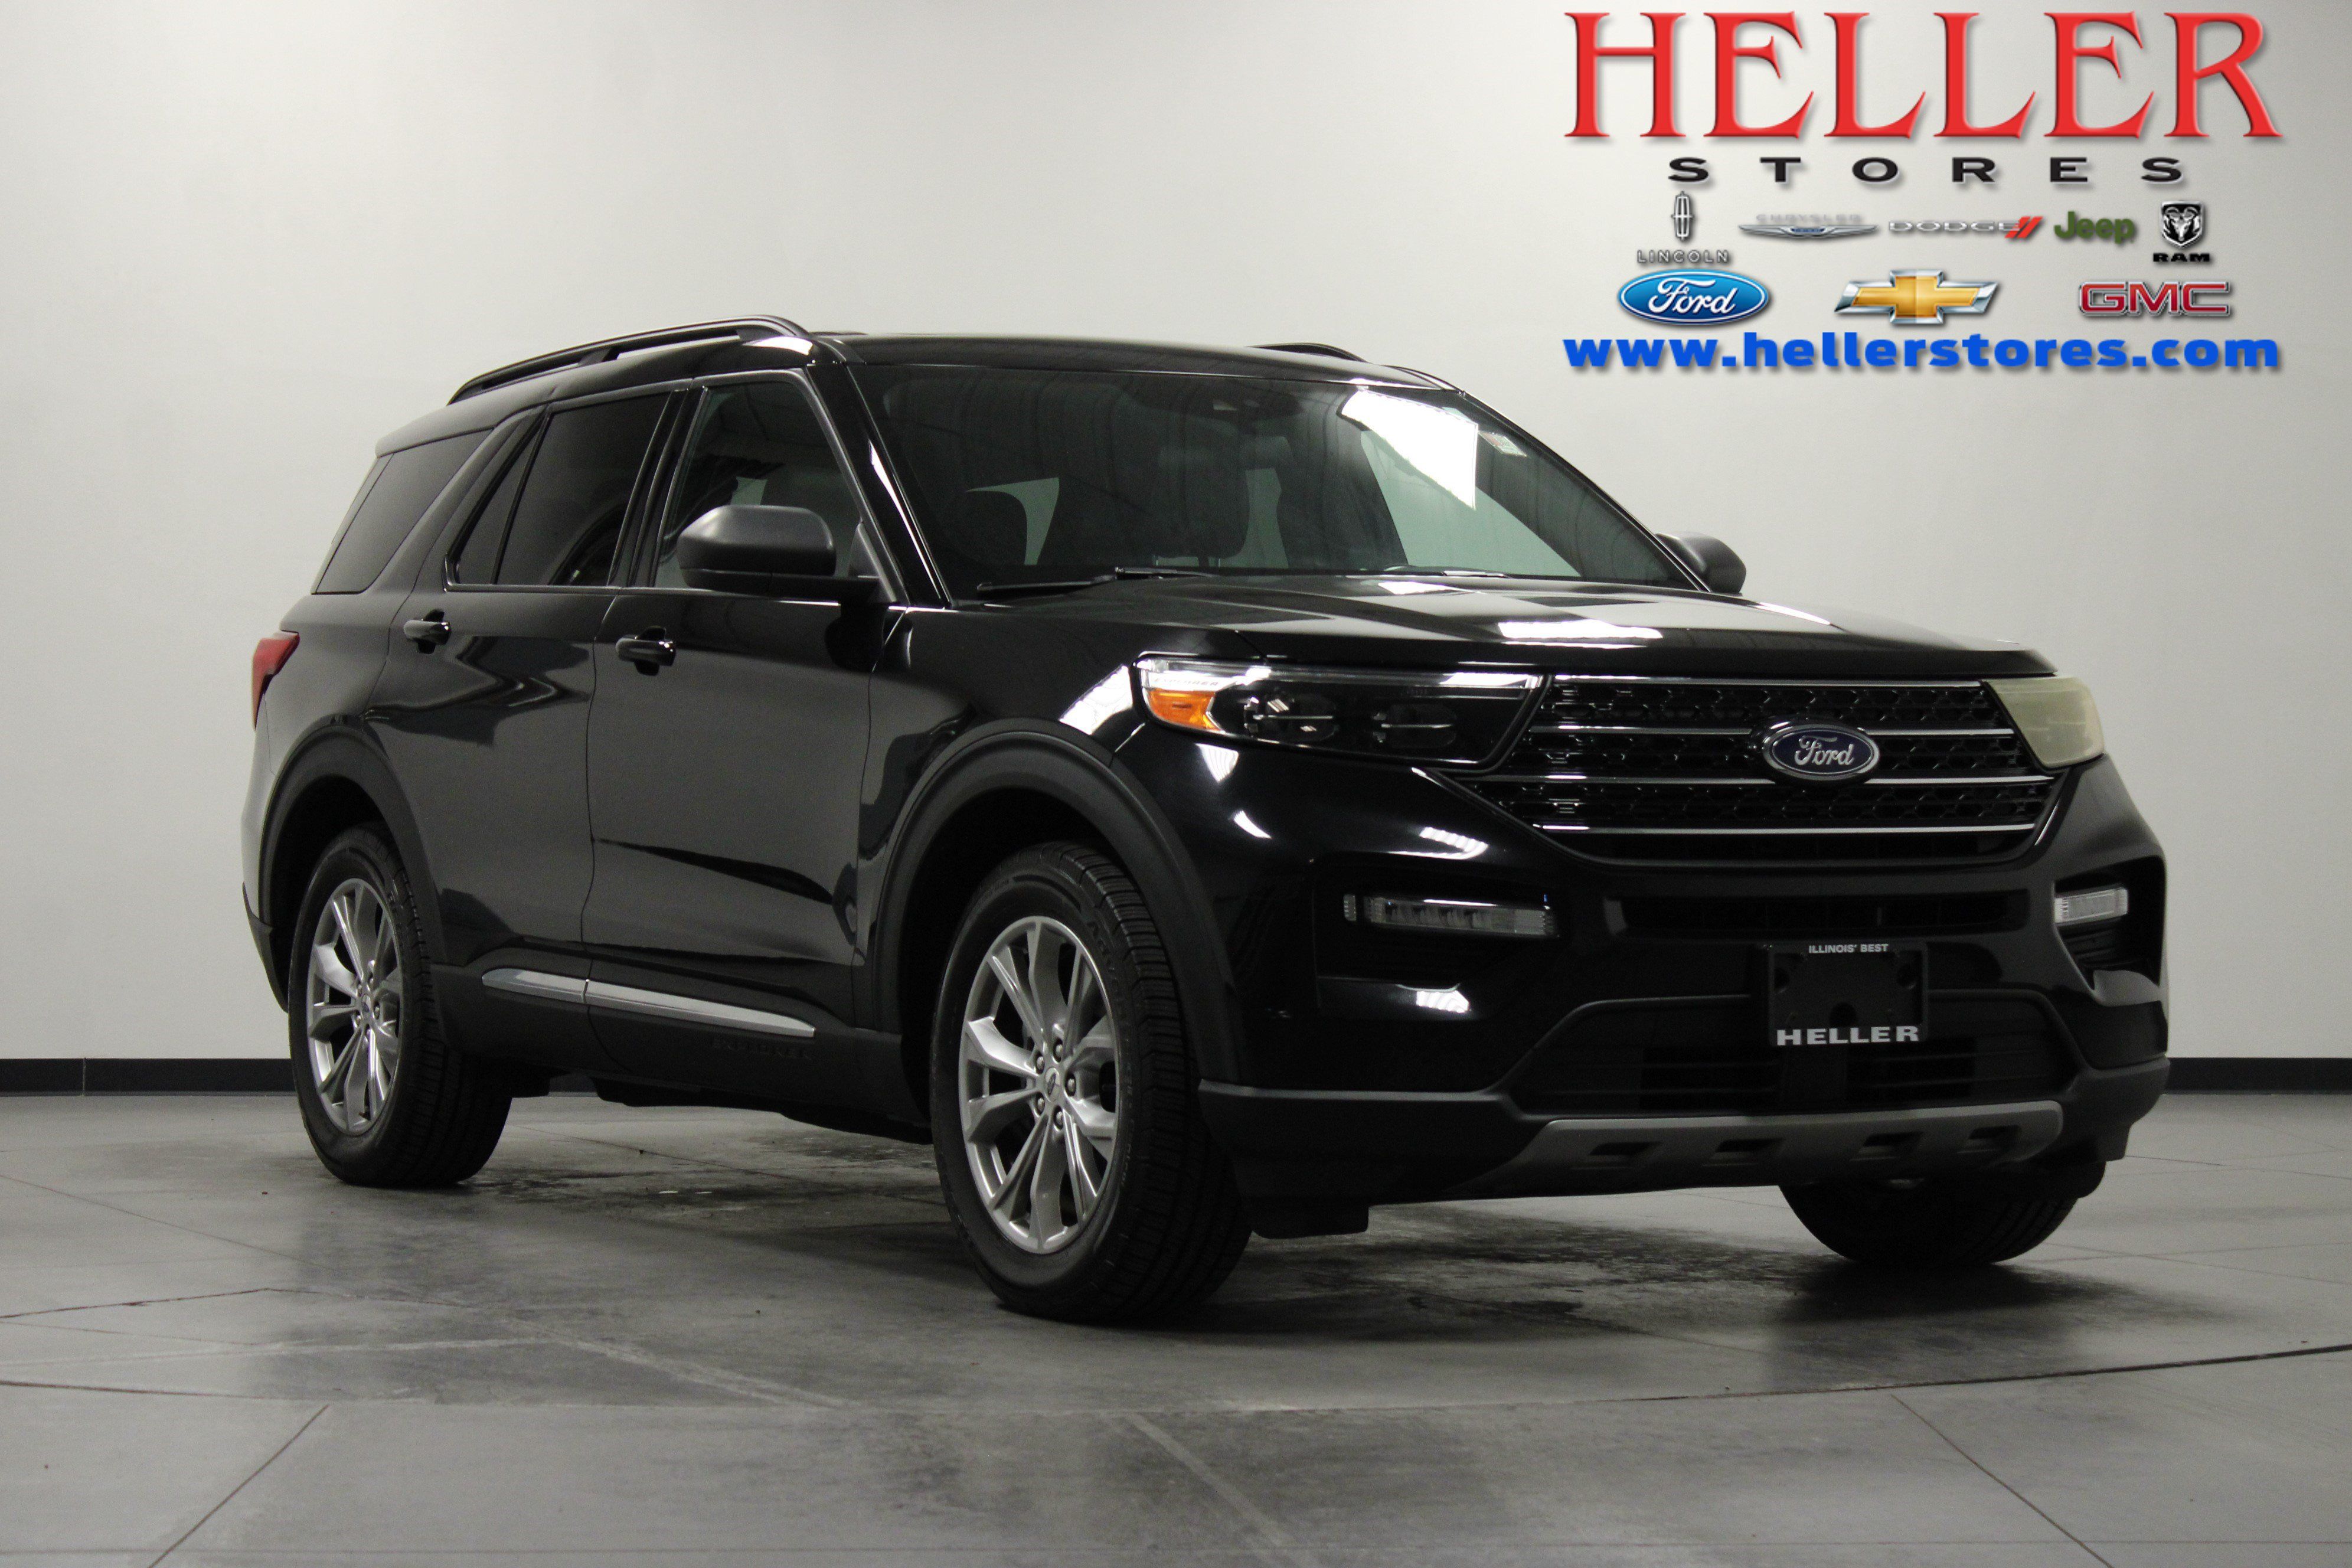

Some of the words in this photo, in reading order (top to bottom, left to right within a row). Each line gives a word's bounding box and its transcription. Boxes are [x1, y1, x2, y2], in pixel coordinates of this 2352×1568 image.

[1794, 735, 1854, 766] Ford
[1860, 943, 1889, 953] BEST
[1776, 1025, 1919, 1046] HELLER
